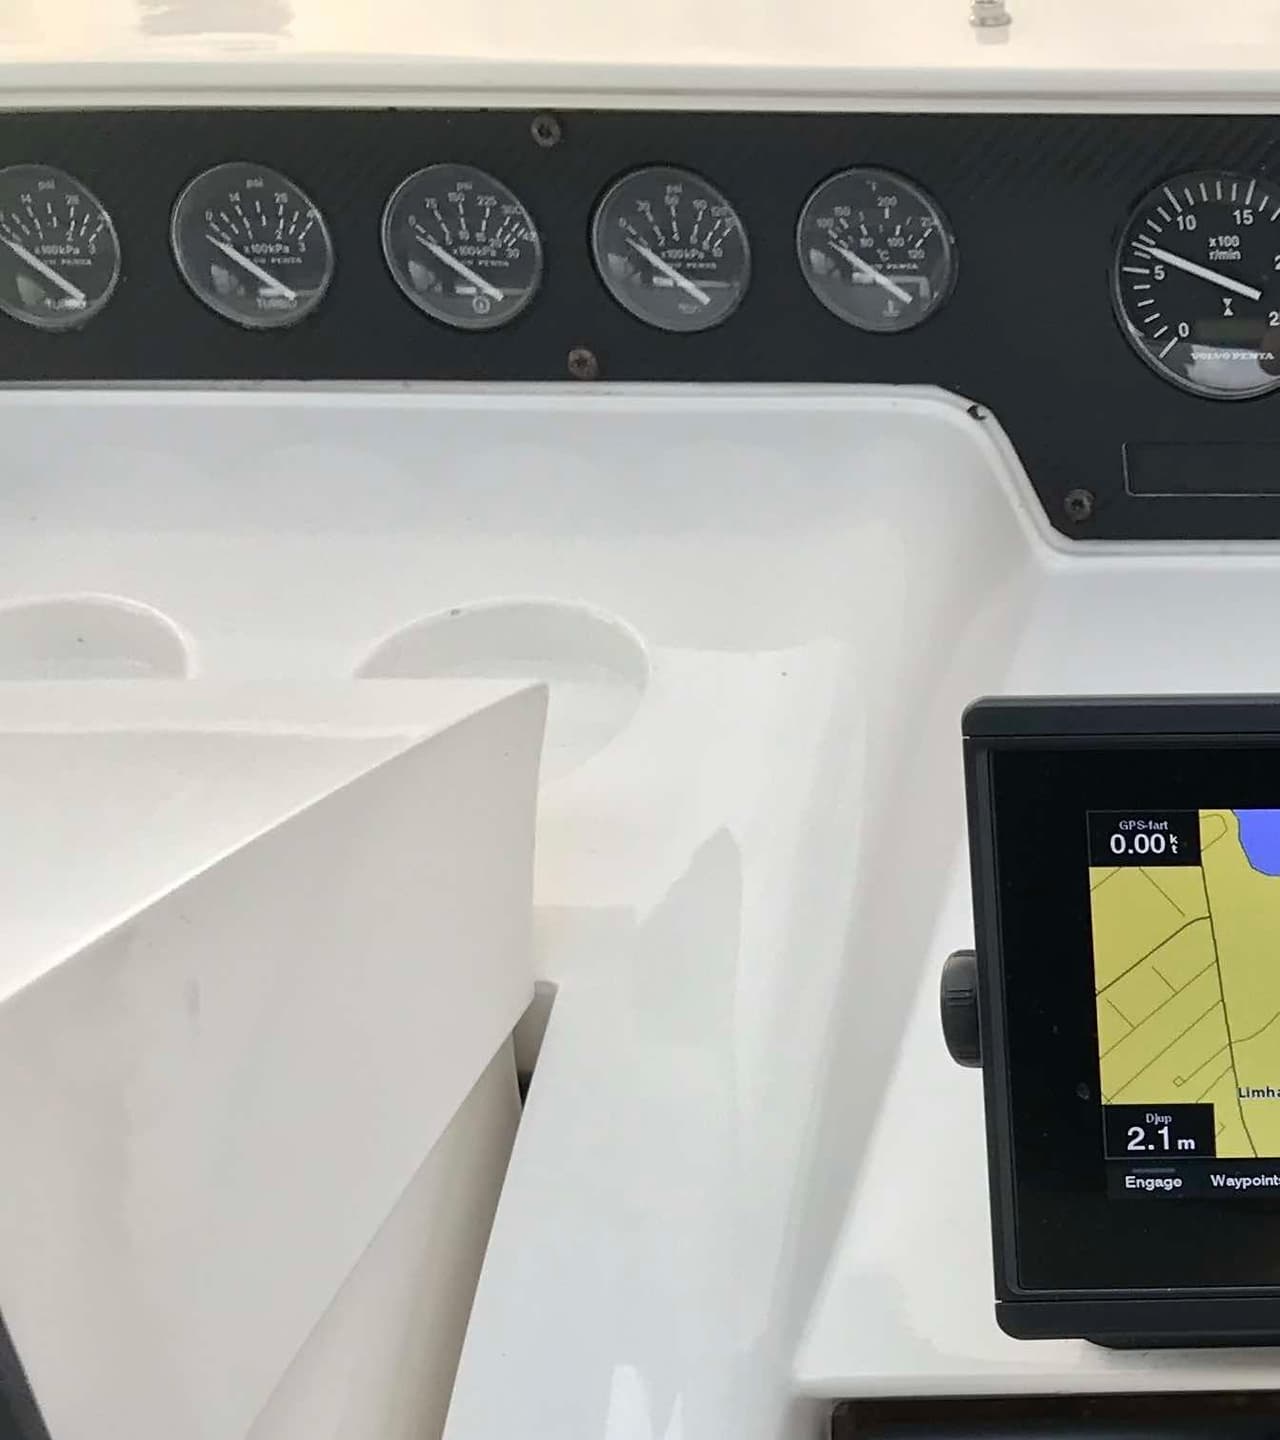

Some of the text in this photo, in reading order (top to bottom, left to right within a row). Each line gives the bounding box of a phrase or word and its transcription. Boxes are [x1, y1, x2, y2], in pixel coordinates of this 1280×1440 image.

[1177, 215, 1197, 231] 10
[1233, 209, 1254, 225] 15
[1209, 235, 1240, 247] x100
[1209, 249, 1241, 261] r/min
[1154, 265, 1165, 280] 5
[1179, 322, 1190, 338] 0
[1191, 352, 1275, 361] VOLVO PENTA
[1119, 820, 1168, 831] GPS-fart
[1110, 833, 1166, 854] 0.00
[1146, 1113, 1172, 1125] Djup
[1126, 1126, 1196, 1151] 2.1 m
[1125, 1175, 1183, 1191] Engage
